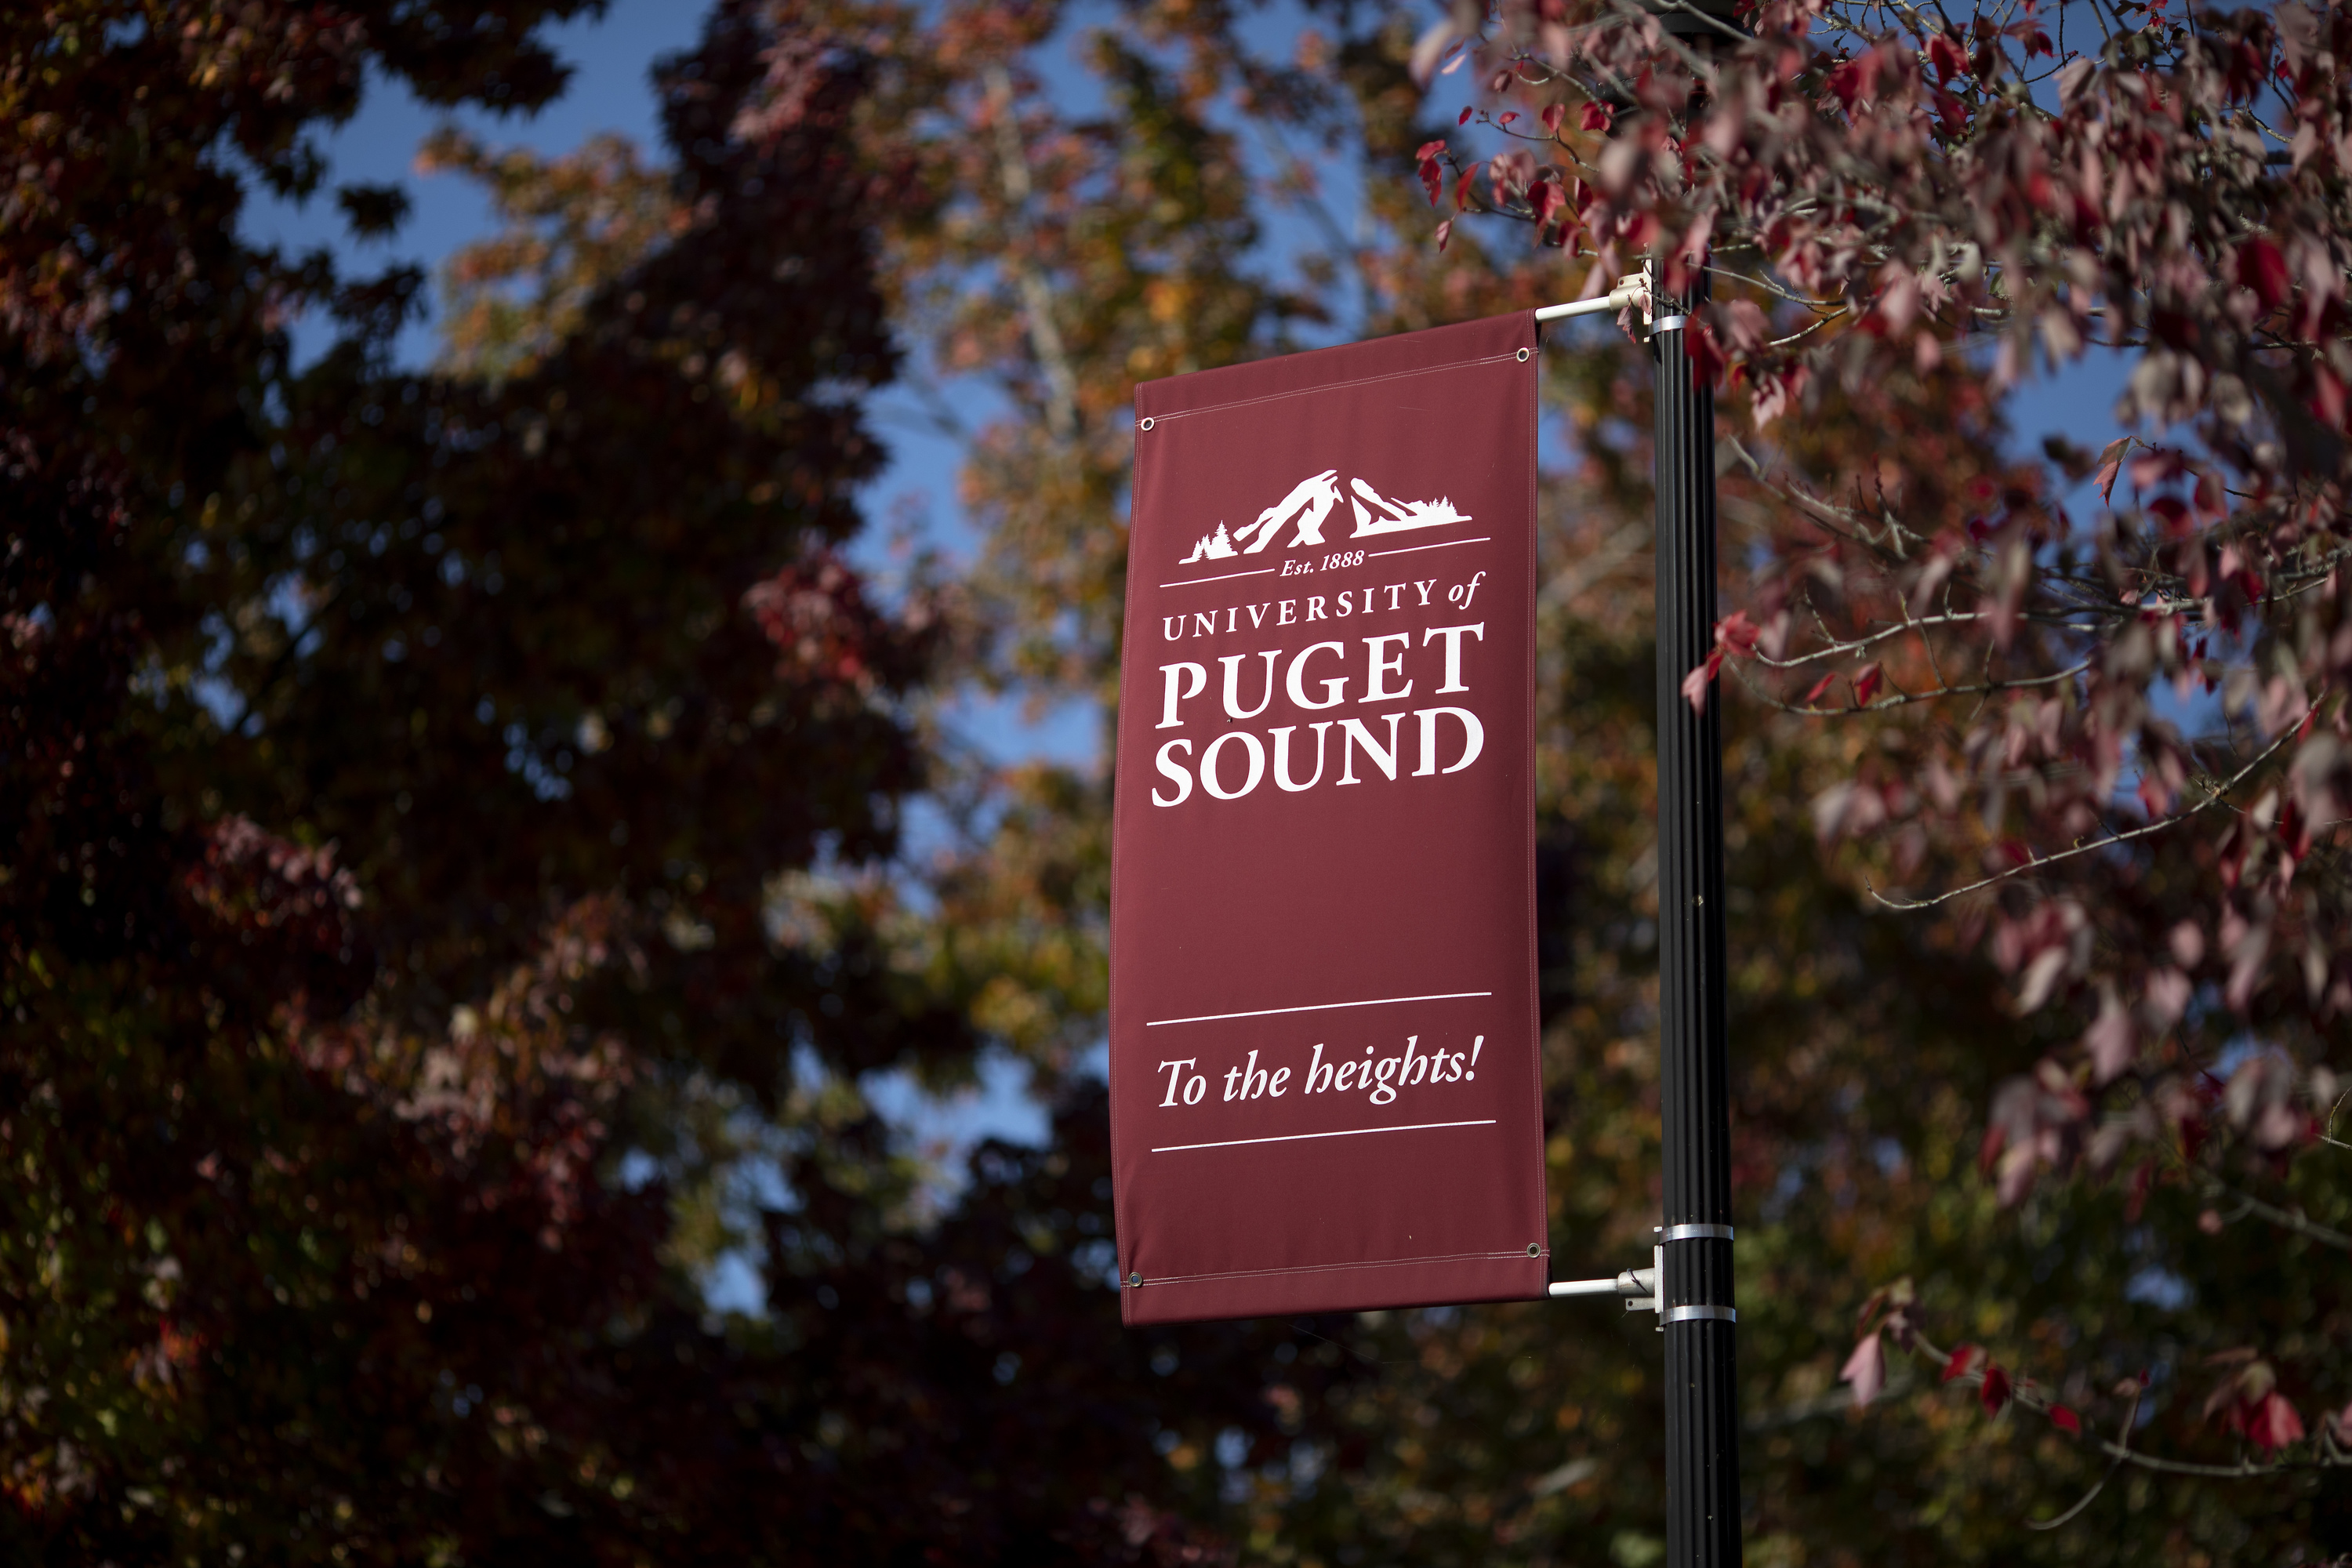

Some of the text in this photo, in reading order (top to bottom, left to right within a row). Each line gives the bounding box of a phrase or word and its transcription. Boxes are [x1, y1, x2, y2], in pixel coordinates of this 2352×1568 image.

[1279, 550, 1365, 577] Est. 1888
[1162, 571, 1486, 641] UNIVERSITY of
[1155, 622, 1485, 730] PUGET
[1151, 706, 1485, 808] SOUND
[1157, 1035, 1485, 1108] To the heights!
